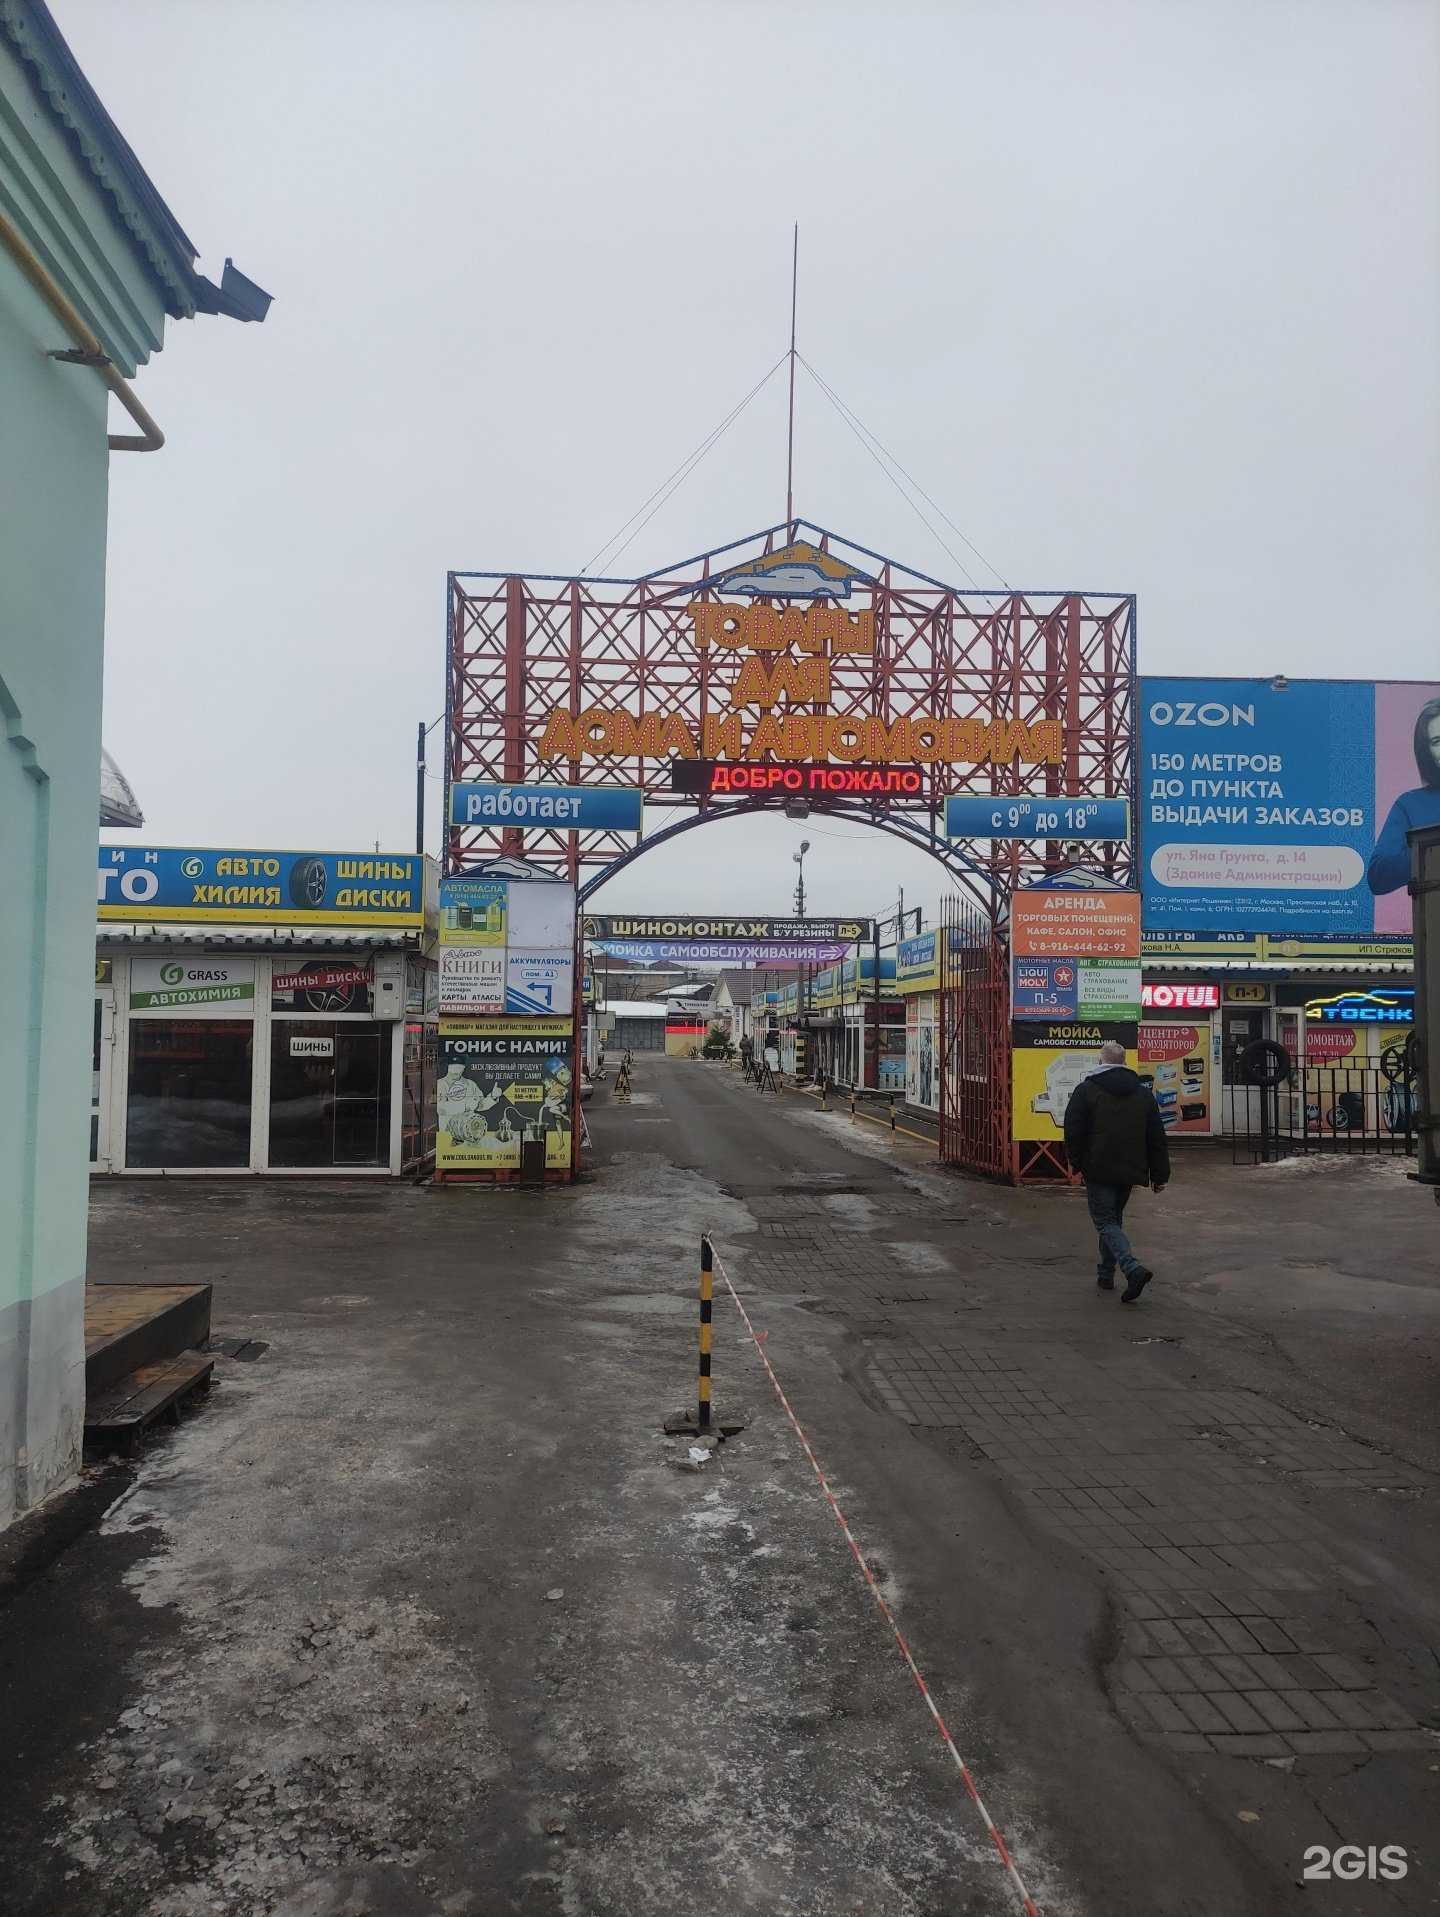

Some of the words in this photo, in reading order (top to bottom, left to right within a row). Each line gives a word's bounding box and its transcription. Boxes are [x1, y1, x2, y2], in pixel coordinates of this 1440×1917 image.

[688, 603, 875, 654] ТОВАРЫ
[731, 655, 831, 707] ДЛЯ
[1150, 702, 1254, 726] OZON
[538, 707, 699, 760] ДОМА
[702, 712, 742, 759] И
[746, 714, 1063, 764] АВТОМОБИЛЯ
[1151, 754, 1184, 771] 150
[1191, 755, 1282, 773] МЕТРОВ
[711, 767, 802, 791] ДОБРО
[810, 769, 921, 792] ПОЖАЛО
[1150, 779, 1184, 799] ДО
[1191, 780, 1283, 798] ПУНКТА
[467, 788, 582, 822] работает
[991, 812, 1002, 828] с
[1035, 812, 1058, 833] до
[1151, 806, 1248, 826] ВЫДАЧИ
[1255, 808, 1364, 826] ЗАКАЗОВ
[1167, 851, 1186, 862] ул.
[1190, 850, 1216, 862] Яна
[1220, 851, 1270, 864] Грунта,
[1276, 854, 1290, 865] д.
[1294, 852, 1307, 863] 14
[216, 858, 280, 876] АВТО
[336, 861, 411, 880] ШИНЫ
[1166, 867, 1221, 881] (Здание
[1224, 868, 1342, 884] Администрации)
[97, 867, 159, 901] ТО
[445, 884, 503, 893] АВТОМАСЛА
[192, 885, 281, 905] ХИМИЯ
[335, 888, 411, 908] ДИСКИ
[1044, 897, 1106, 910] АРЕНДА
[1018, 914, 1069, 922] ТОРГОВЫХ
[1071, 914, 1136, 924] ПОМЕЩЕНИЙ,
[612, 921, 769, 937] ШИНОМОНТАЖ
[1027, 928, 1056, 936] КАФЕ,
[1058, 928, 1095, 937] САЛОН,
[1098, 928, 1127, 936] ОФИС
[660, 946, 817, 958] САМООБСЛУЖИВАНИЯ
[1040, 942, 1126, 952] 8-916-644-62-92
[1375, 945, 1412, 955] Стрюков
[442, 961, 502, 974] КНИГИ
[510, 957, 571, 966] АККУМУЛЯТОРЫ
[187, 970, 228, 981] GRASS
[276, 976, 319, 989] ШИНЫ
[326, 971, 371, 985] ДИСКИ
[1019, 968, 1047, 977] LIQUI
[1019, 978, 1047, 987] MOLY
[149, 987, 242, 1006] АВТОХИМИЯ
[1034, 993, 1058, 1004] П-5
[1141, 985, 1217, 1006] MOTUL
[1235, 986, 1258, 998] П-1
[440, 1004, 485, 1012] ПАВИЛЬОН
[1049, 1024, 1102, 1038] МОЙКА
[1143, 1028, 1180, 1040] ЦЕНТР
[292, 1042, 331, 1053] ШИНЫ
[445, 1040, 492, 1053] ГОНИ
[495, 1040, 506, 1053] С
[510, 1040, 567, 1053] НАМИ!
[471, 1062, 516, 1071] ЭКСКЛЮЗИВНЫЙ
[517, 1063, 544, 1072] ПРОДУКТ
